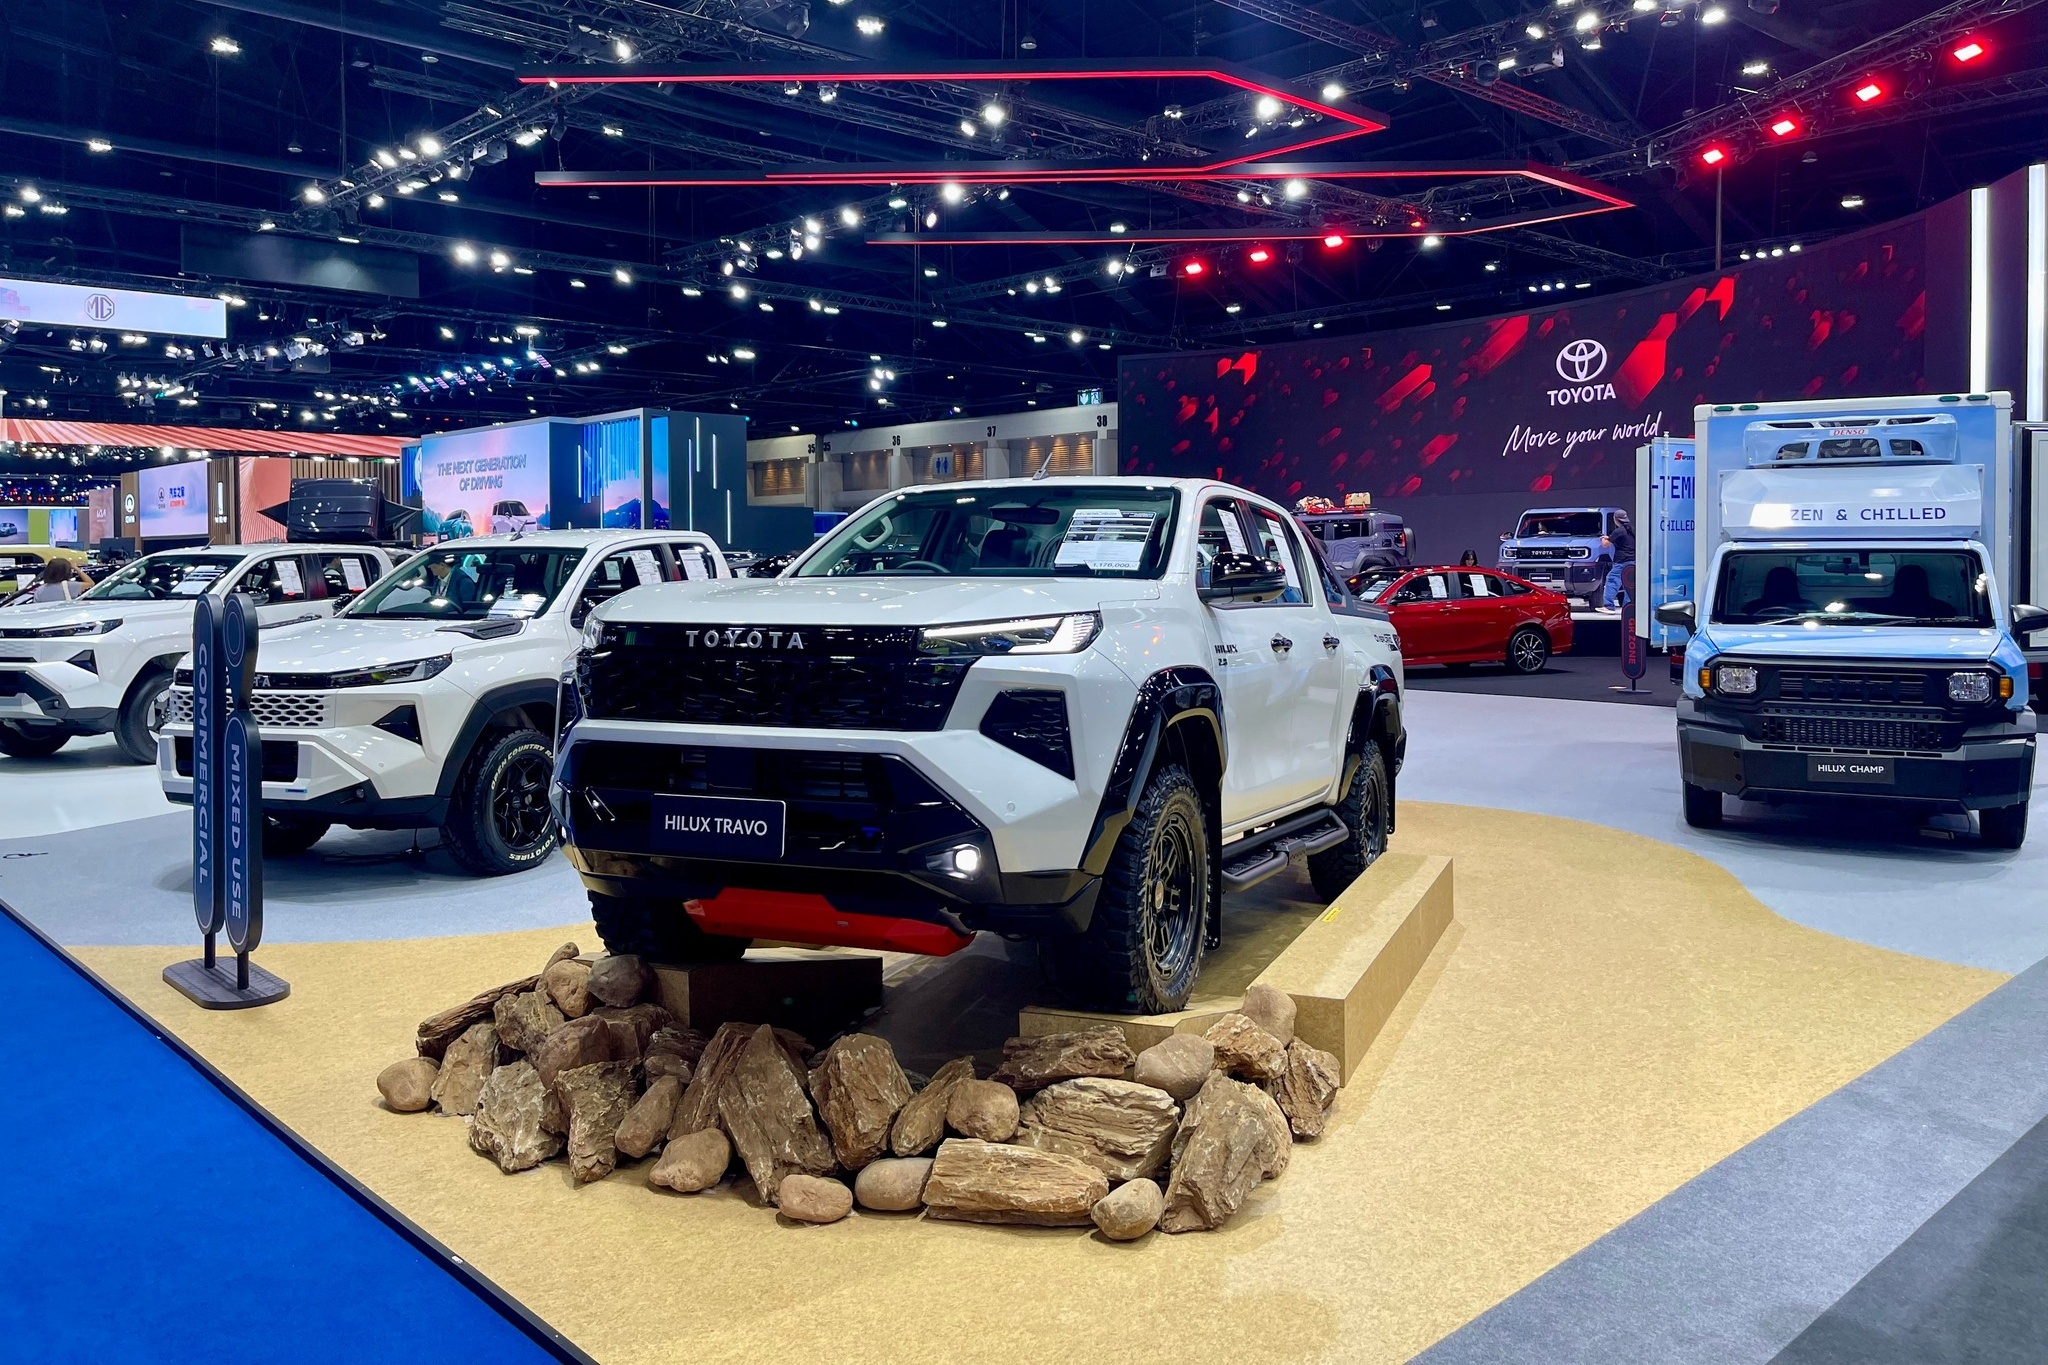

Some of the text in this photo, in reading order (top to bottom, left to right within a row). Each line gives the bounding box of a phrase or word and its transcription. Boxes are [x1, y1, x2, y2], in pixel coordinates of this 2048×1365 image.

[87, 296, 112, 318] MG
[1547, 383, 1616, 406] TOYOTA
[987, 426, 997, 437] 37
[1096, 415, 1108, 427] 38
[892, 435, 901, 446] 36
[1503, 411, 1662, 458] Move your world
[808, 444, 816, 454] 35
[437, 454, 527, 476] THE NEXT GENERATION
[460, 475, 503, 491] OF DRIVING
[1791, 507, 1946, 521] ZEN & CHILLED
[685, 629, 804, 650] TOYOTA
[1628, 635, 1637, 665] ZONE
[198, 643, 209, 884] COMMERCIAL
[490, 758, 507, 790] OPEN
[507, 743, 545, 760] COUNTRY
[1817, 764, 1885, 774] HILUX CHAMP
[231, 744, 241, 919] MIXED USE
[665, 814, 768, 836] HILUX TRAVO
